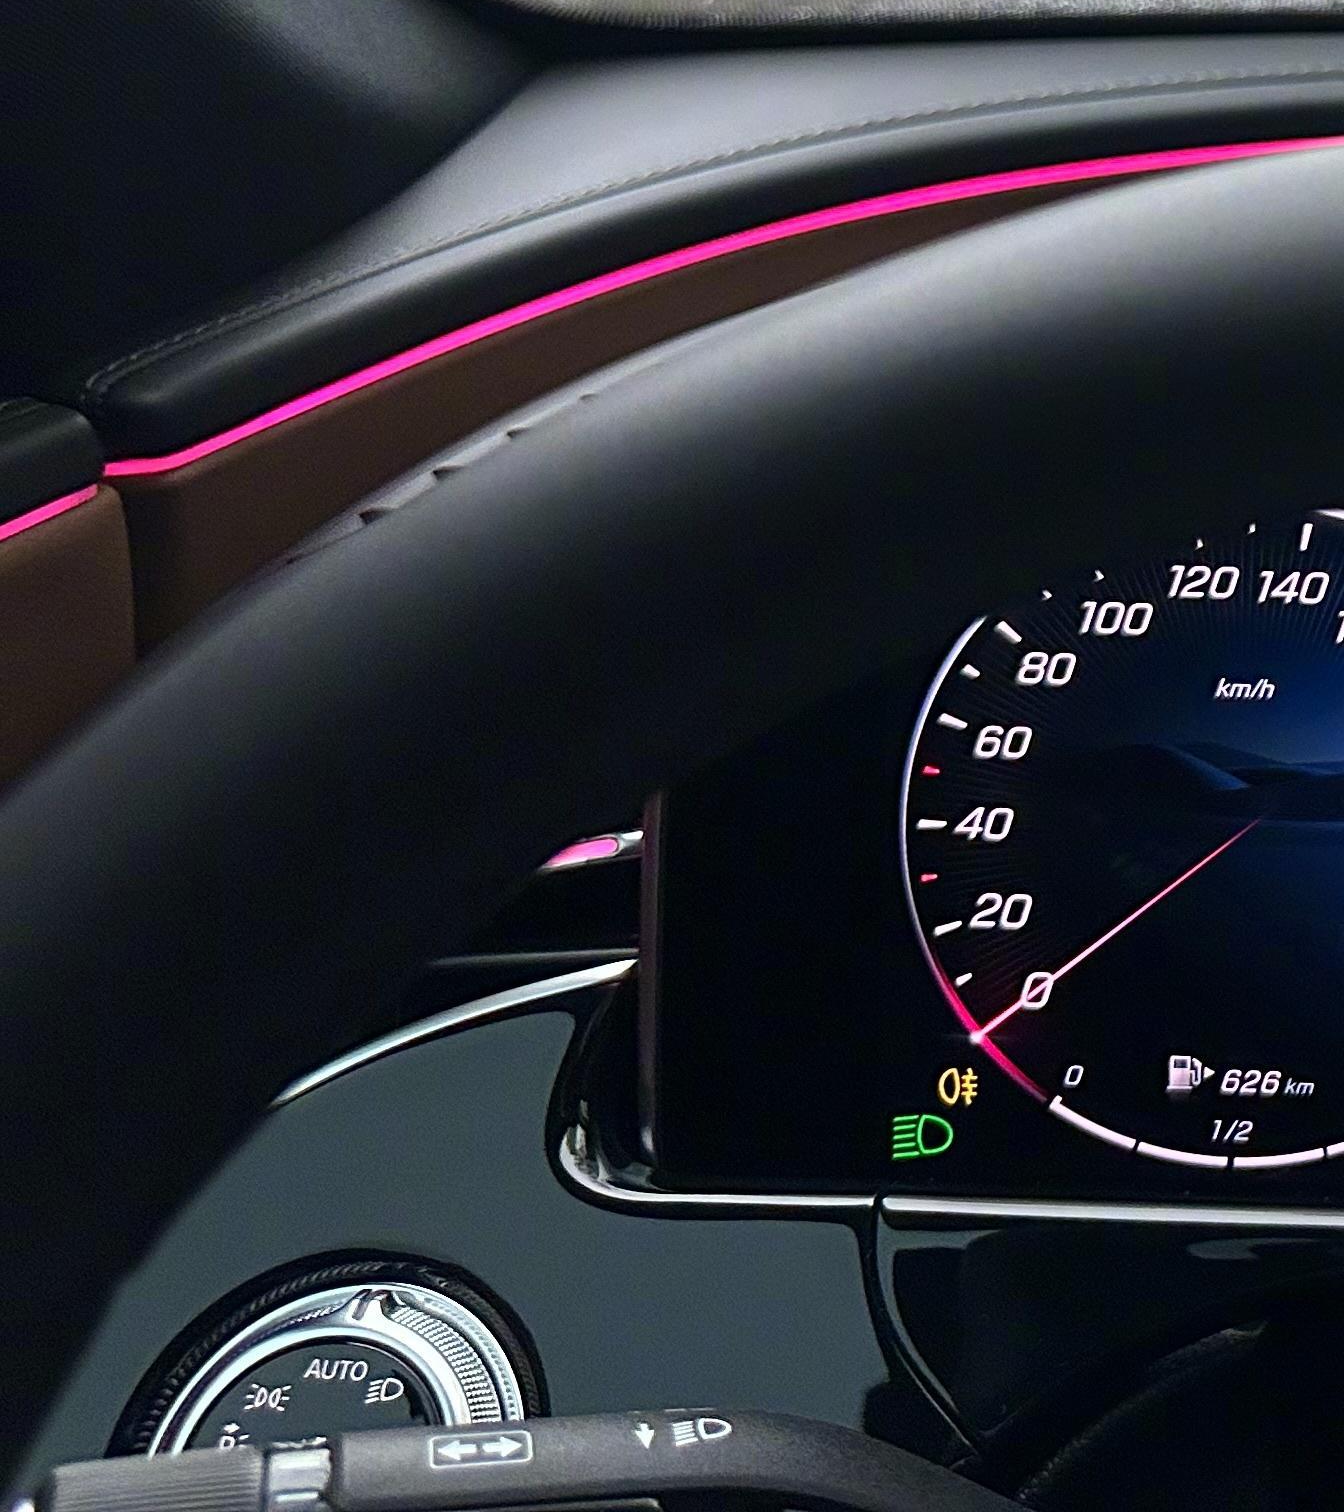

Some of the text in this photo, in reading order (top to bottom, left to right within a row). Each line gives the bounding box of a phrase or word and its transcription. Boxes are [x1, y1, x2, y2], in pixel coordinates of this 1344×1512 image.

[1168, 565, 1239, 599] 120
[1258, 571, 1329, 604] 140
[1080, 601, 1153, 635] 100
[1017, 652, 1076, 685] 80
[1215, 678, 1275, 699] km/h
[974, 725, 1032, 759] 60
[954, 807, 1014, 841] 40
[970, 893, 1032, 929] 20
[1020, 971, 1055, 1010] 0
[1065, 1065, 1084, 1085] 0
[1221, 1069, 1314, 1095] 626 km
[1213, 1120, 1253, 1141] 1/2
[303, 1359, 368, 1381] AUTO
